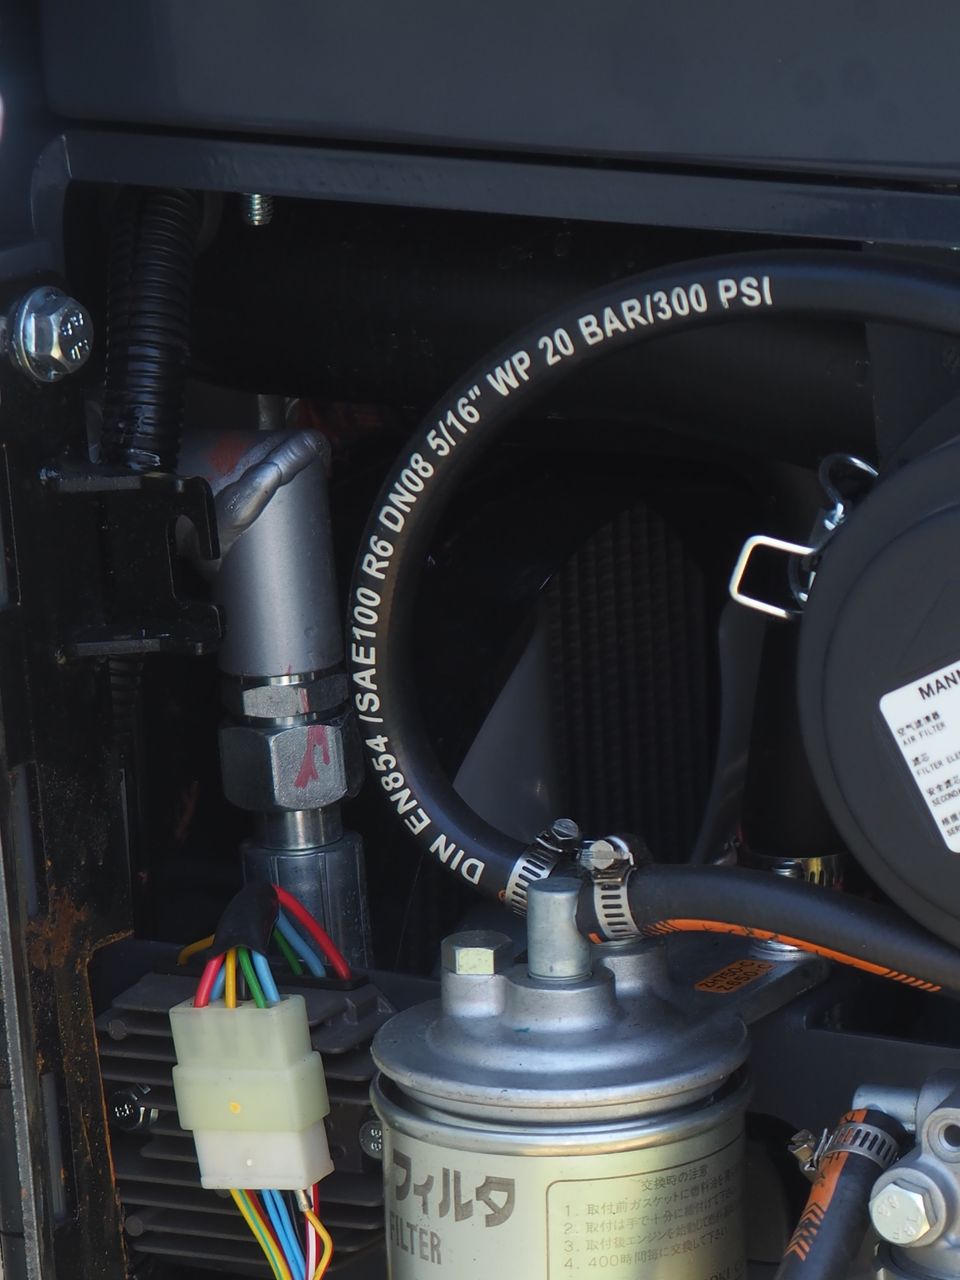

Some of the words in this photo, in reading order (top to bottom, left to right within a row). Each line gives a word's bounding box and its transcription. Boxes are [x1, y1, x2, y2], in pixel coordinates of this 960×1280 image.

[579, 283, 708, 346] BAR/300
[718, 276, 773, 309] PSI
[538, 327, 575, 366] 20
[486, 350, 532, 397] WP
[426, 385, 481, 457] 5/16"
[379, 453, 435, 533] DN08
[361, 535, 395, 580] R6
[351, 585, 383, 723] /SAE100
[902, 733, 917, 747] AIR
[921, 721, 947, 740] FILTER
[365, 734, 432, 836] EN854
[916, 757, 944, 777] FILTER
[429, 833, 486, 885] DIN
[389, 1211, 442, 1265] FILTER
